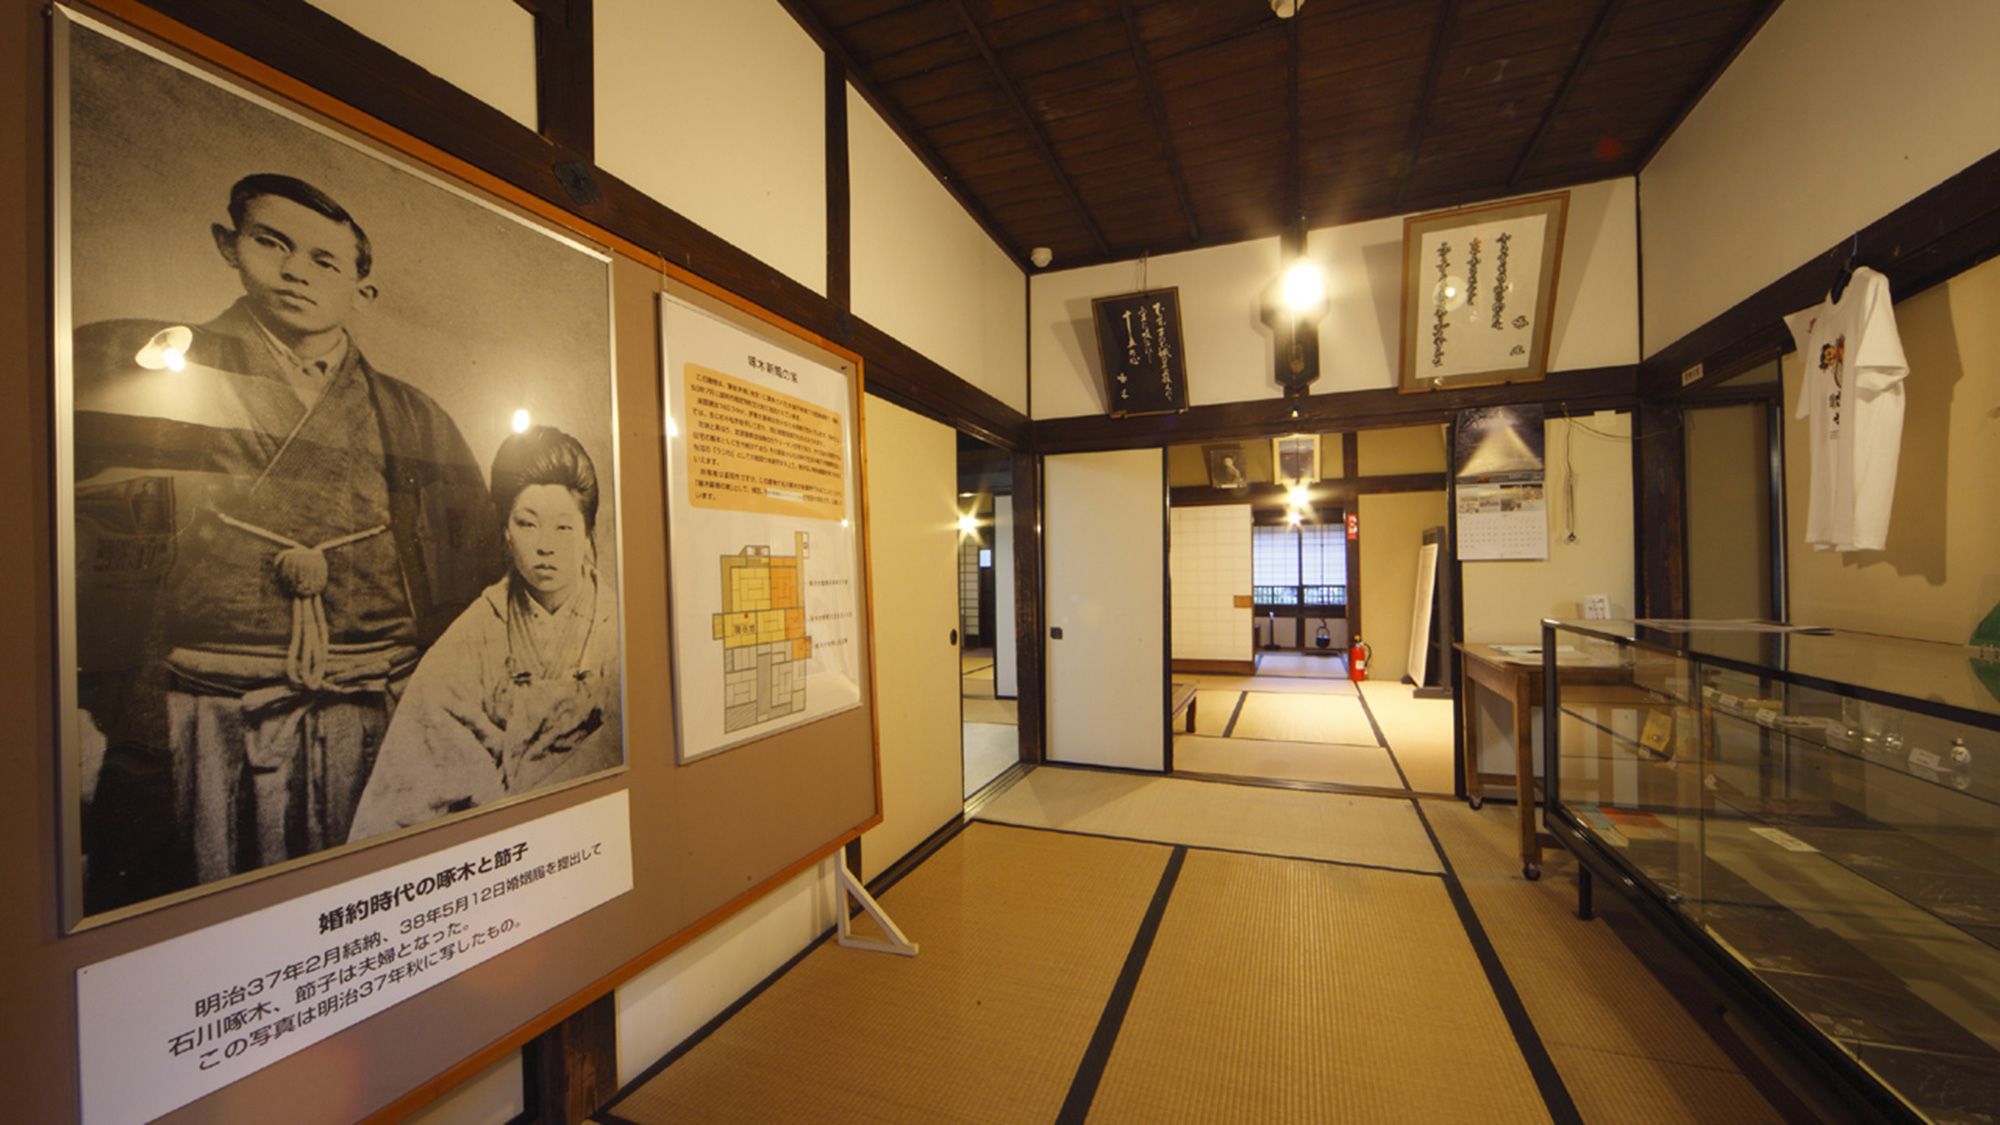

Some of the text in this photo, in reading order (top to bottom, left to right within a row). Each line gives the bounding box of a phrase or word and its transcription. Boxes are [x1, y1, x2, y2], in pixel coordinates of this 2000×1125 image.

[319, 842, 529, 934] 婚約時代の啄木と節子
[168, 921, 470, 1057] 石川啄木、節子は夫婦となった。
[199, 918, 521, 1070] この写真は明治37年秋に写したもの。
